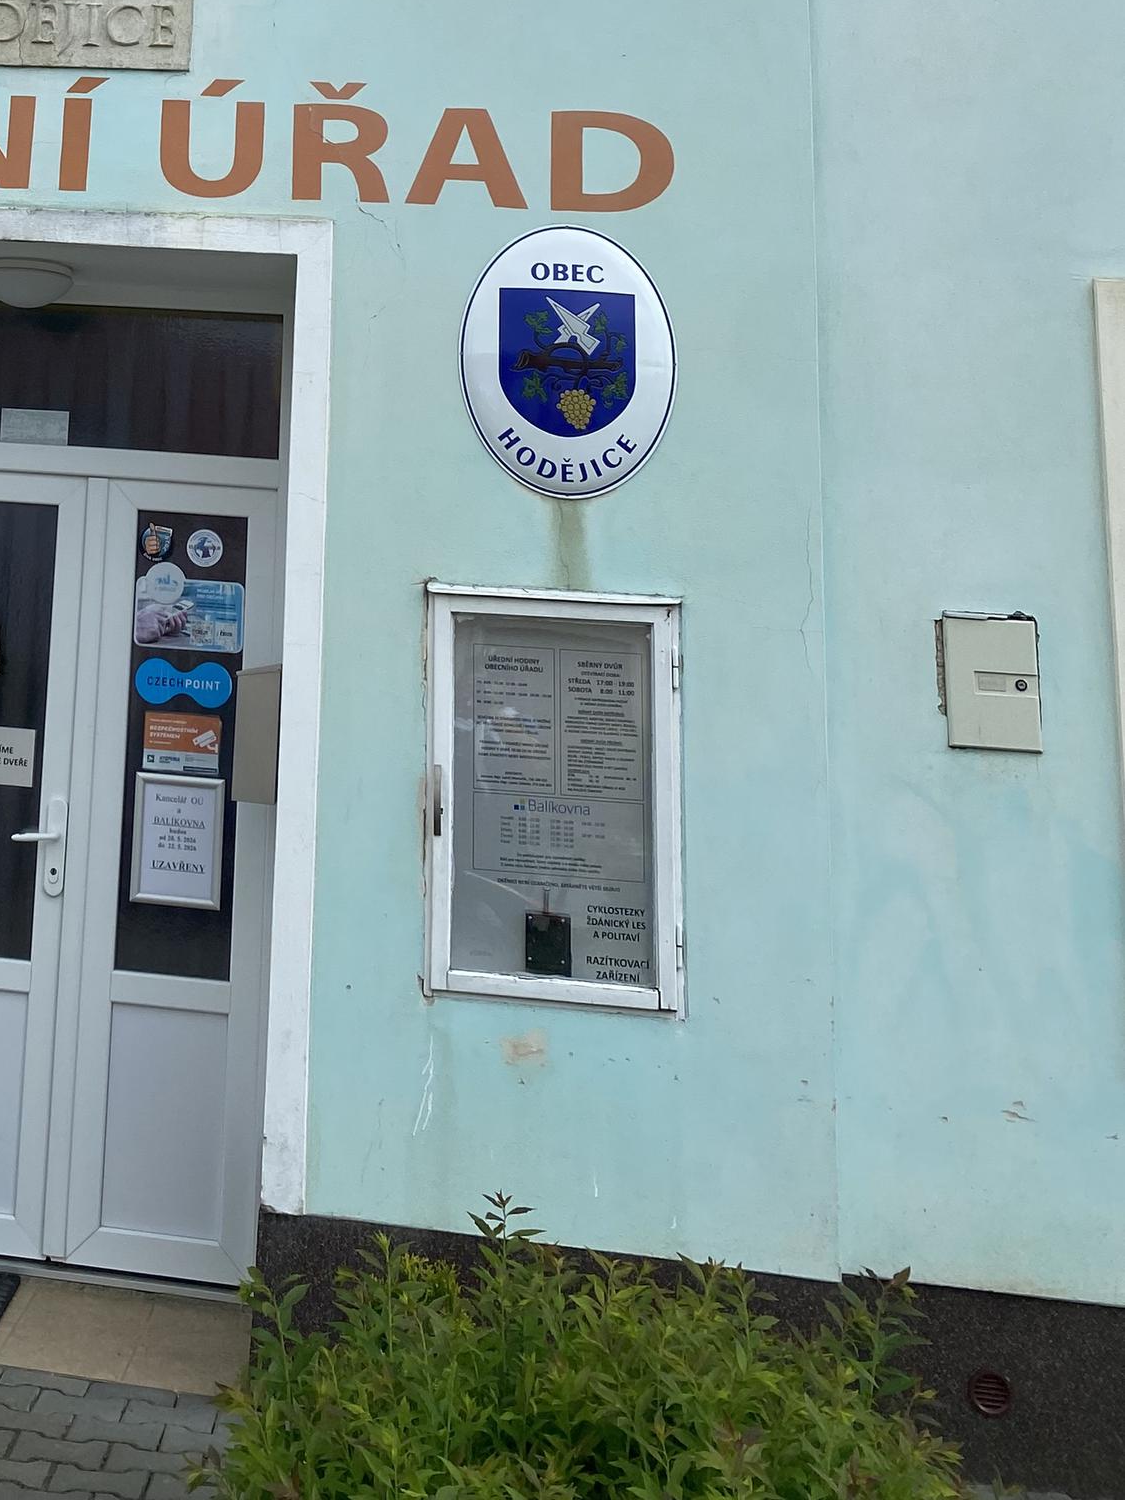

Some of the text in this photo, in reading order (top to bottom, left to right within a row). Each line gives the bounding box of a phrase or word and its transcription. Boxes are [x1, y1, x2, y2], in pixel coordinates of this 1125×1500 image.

[159, 78, 676, 213] ÚŘAD
[530, 262, 605, 284] OBEC
[497, 427, 637, 483] HODĚJICE
[568, 677, 591, 685] STŘEDA
[3, 757, 28, 767] DVEŘE
[155, 793, 187, 804] Kancelář
[528, 799, 591, 816] Balíkovna
[153, 816, 205, 829] BALÍKOVNA
[151, 860, 205, 873] UZAVŘENY
[587, 905, 645, 917] CYKLOSTEZKY
[587, 915, 646, 930] ŽDÁNICKÝ LES
[602, 931, 640, 942] POLITAVÍ
[586, 955, 650, 969] RAZÍTKOVACÍ
[596, 970, 640, 983] ZAŘÍZENÍ
